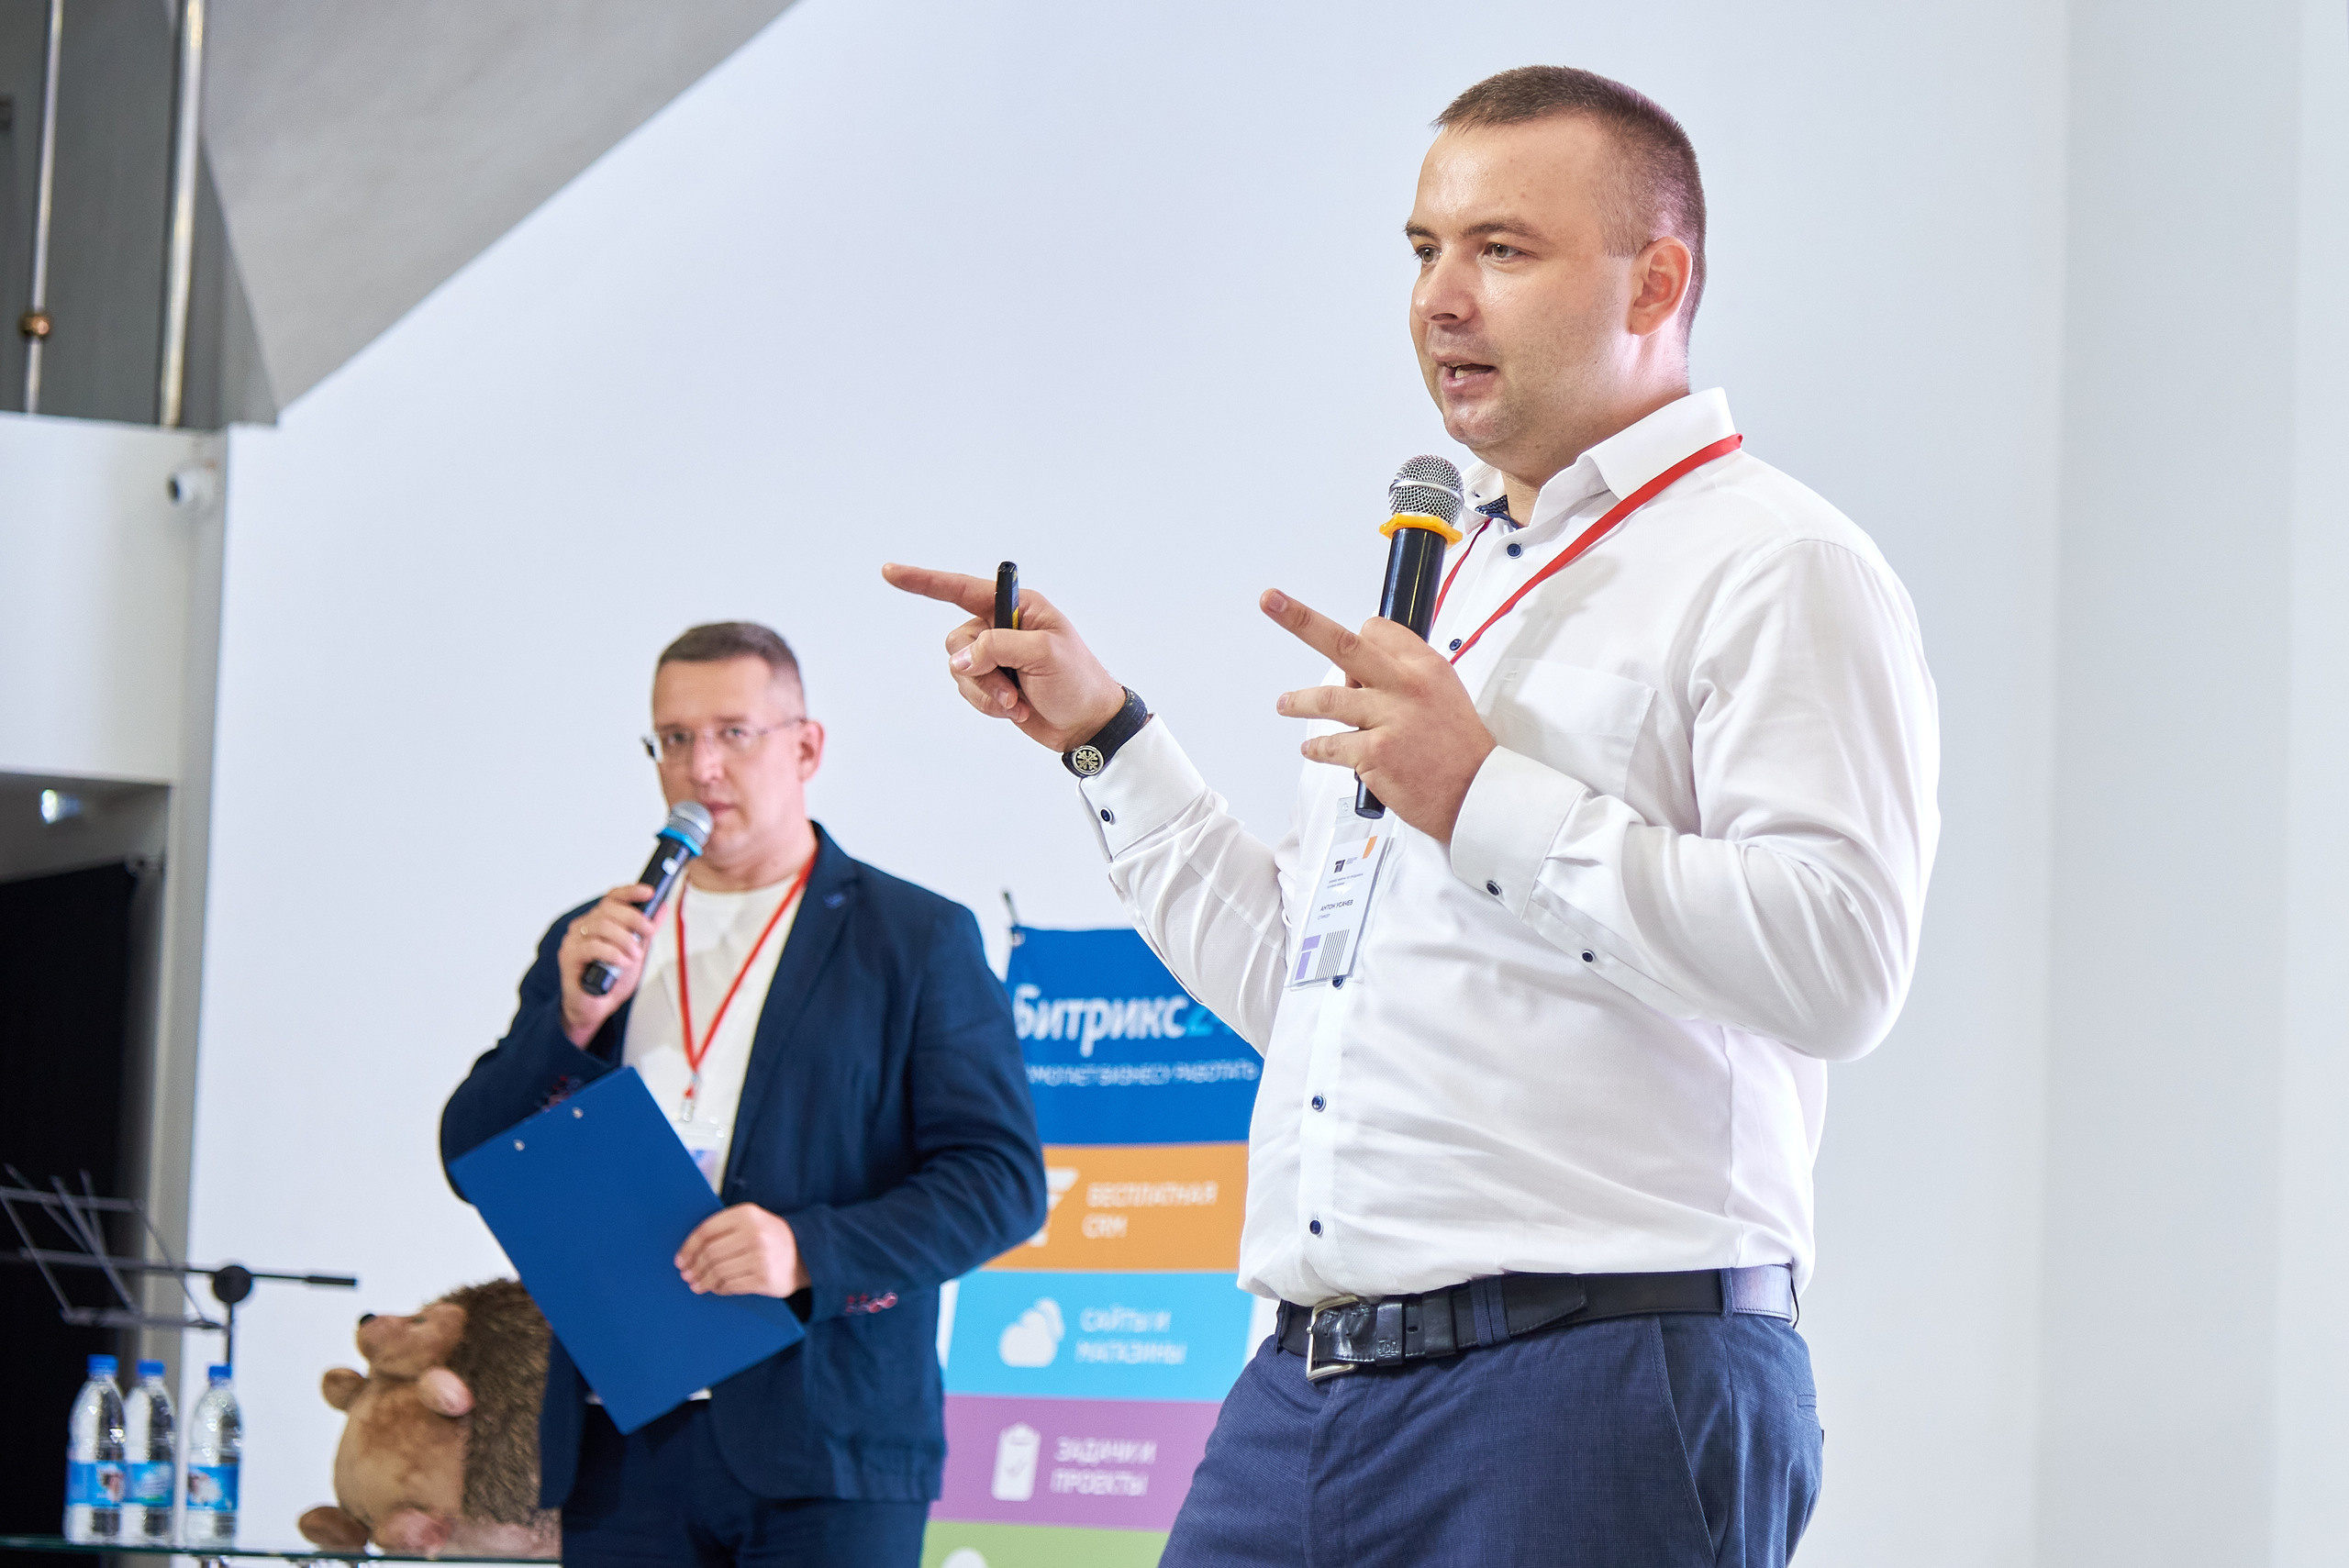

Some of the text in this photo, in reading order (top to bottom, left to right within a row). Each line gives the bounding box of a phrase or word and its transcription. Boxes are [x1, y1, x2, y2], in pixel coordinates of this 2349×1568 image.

[1012, 983, 1232, 1058] Битрикс2
[1086, 1181, 1219, 1207] БЕСПЛАТНАЯ
[1082, 1212, 1129, 1240] CRM
[1079, 1304, 1173, 1332] САЙТЫ И
[1074, 1339, 1188, 1365] МАГАЗИНЫ
[1055, 1436, 1158, 1466] ЗАДАЧИ И
[1050, 1468, 1150, 1497] ПРОЕКТЫ
